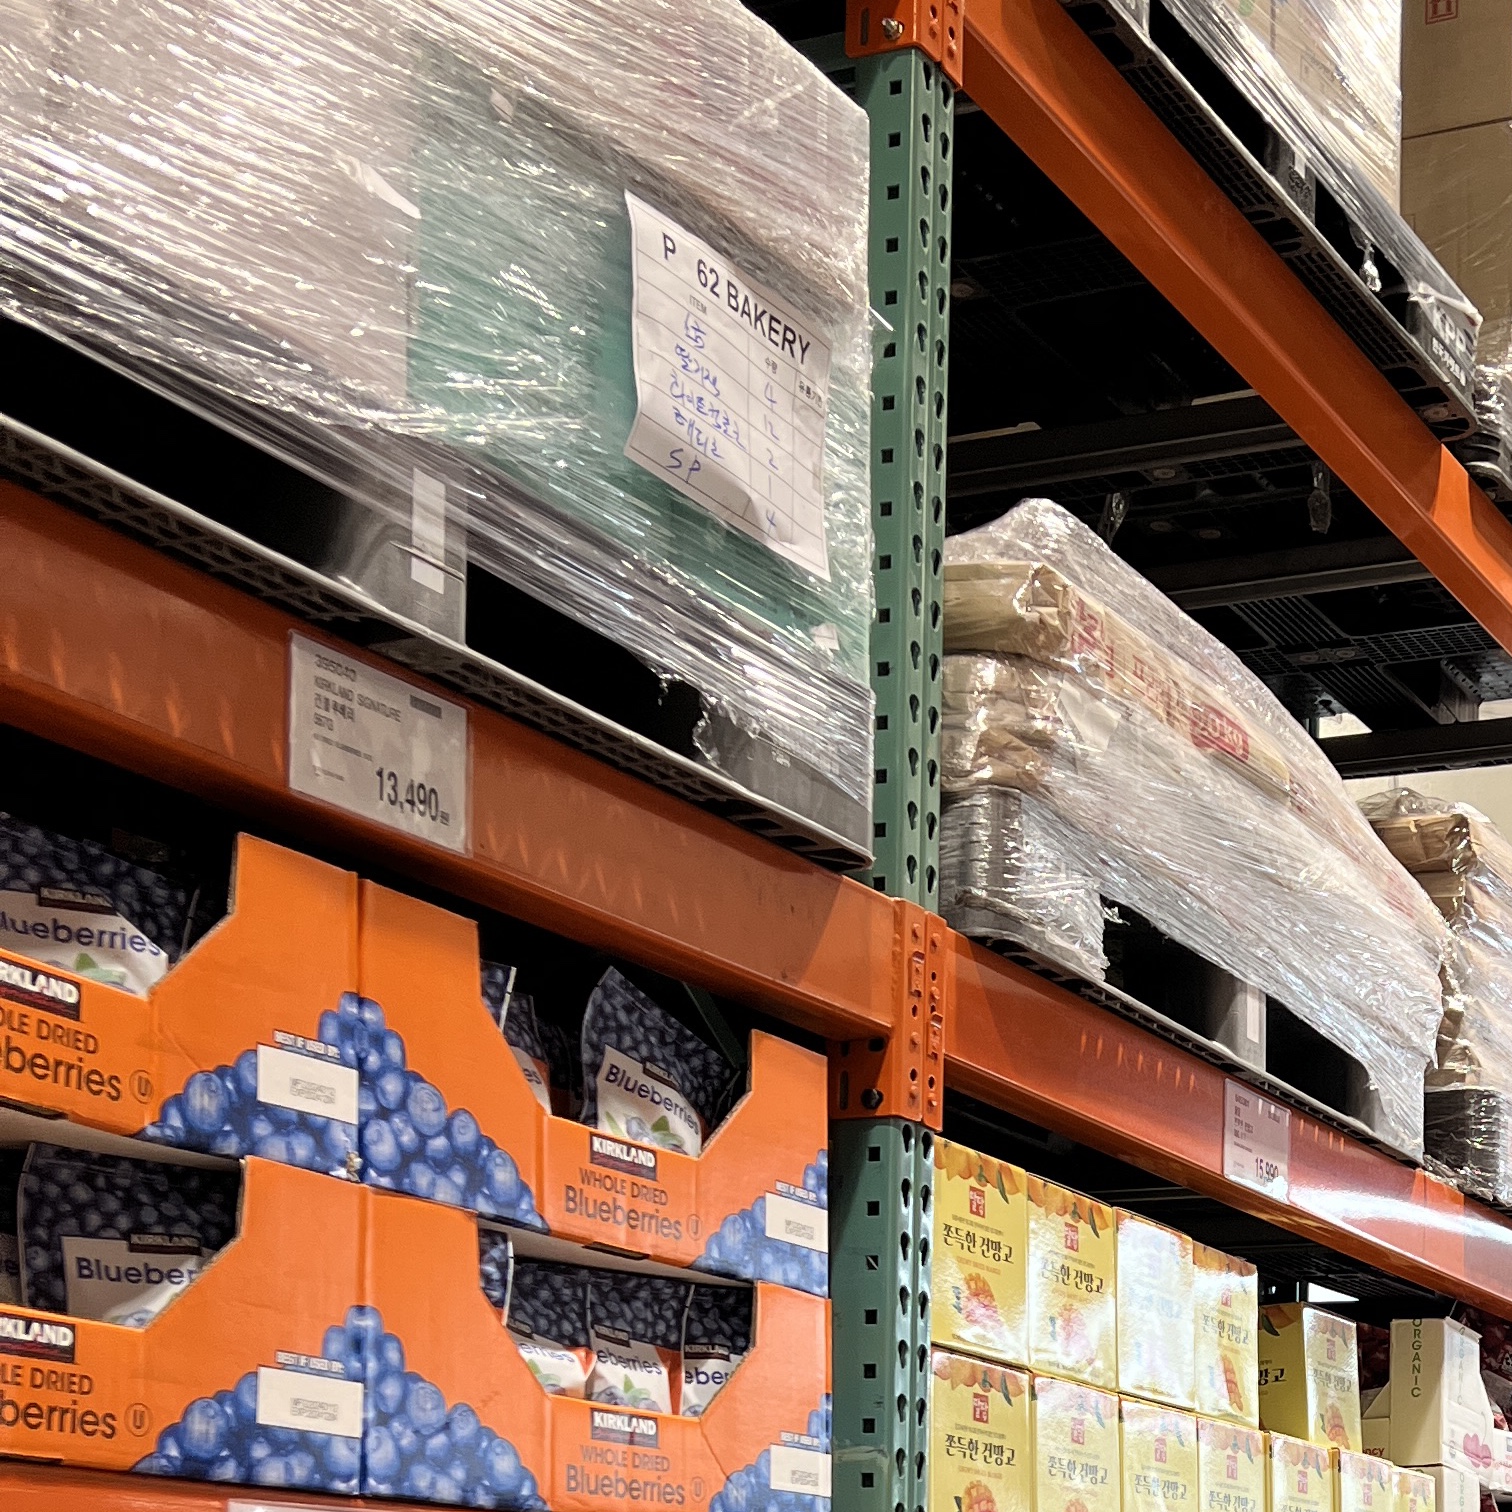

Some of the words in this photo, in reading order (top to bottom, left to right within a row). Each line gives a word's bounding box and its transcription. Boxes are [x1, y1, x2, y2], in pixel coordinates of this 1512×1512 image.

[662, 232, 676, 260] P
[697, 258, 720, 299] 62
[727, 280, 810, 365] BAKERY
[689, 295, 707, 315] ITEM
[37, 1019, 98, 1053] DRIED
[605, 1062, 701, 1136] Blueberries
[592, 1135, 656, 1168] KIRKLAND
[579, 1166, 627, 1197] WHOLE
[631, 1181, 668, 1207] DRIED
[564, 1184, 683, 1241] Blueberries
[943, 1223, 977, 1253] 쫀득한
[979, 1236, 1014, 1265] 건망고
[593, 1411, 657, 1436] KIRKLAND
[580, 1444, 629, 1468] WHOLE
[632, 1453, 670, 1472] DRIED
[945, 1433, 979, 1461] 쫀득한
[982, 1442, 1016, 1467] 건망고
[565, 1464, 686, 1506] Blueberries
[1048, 1455, 1078, 1481] 쫀득한
[1079, 1462, 1109, 1485] 건망고
